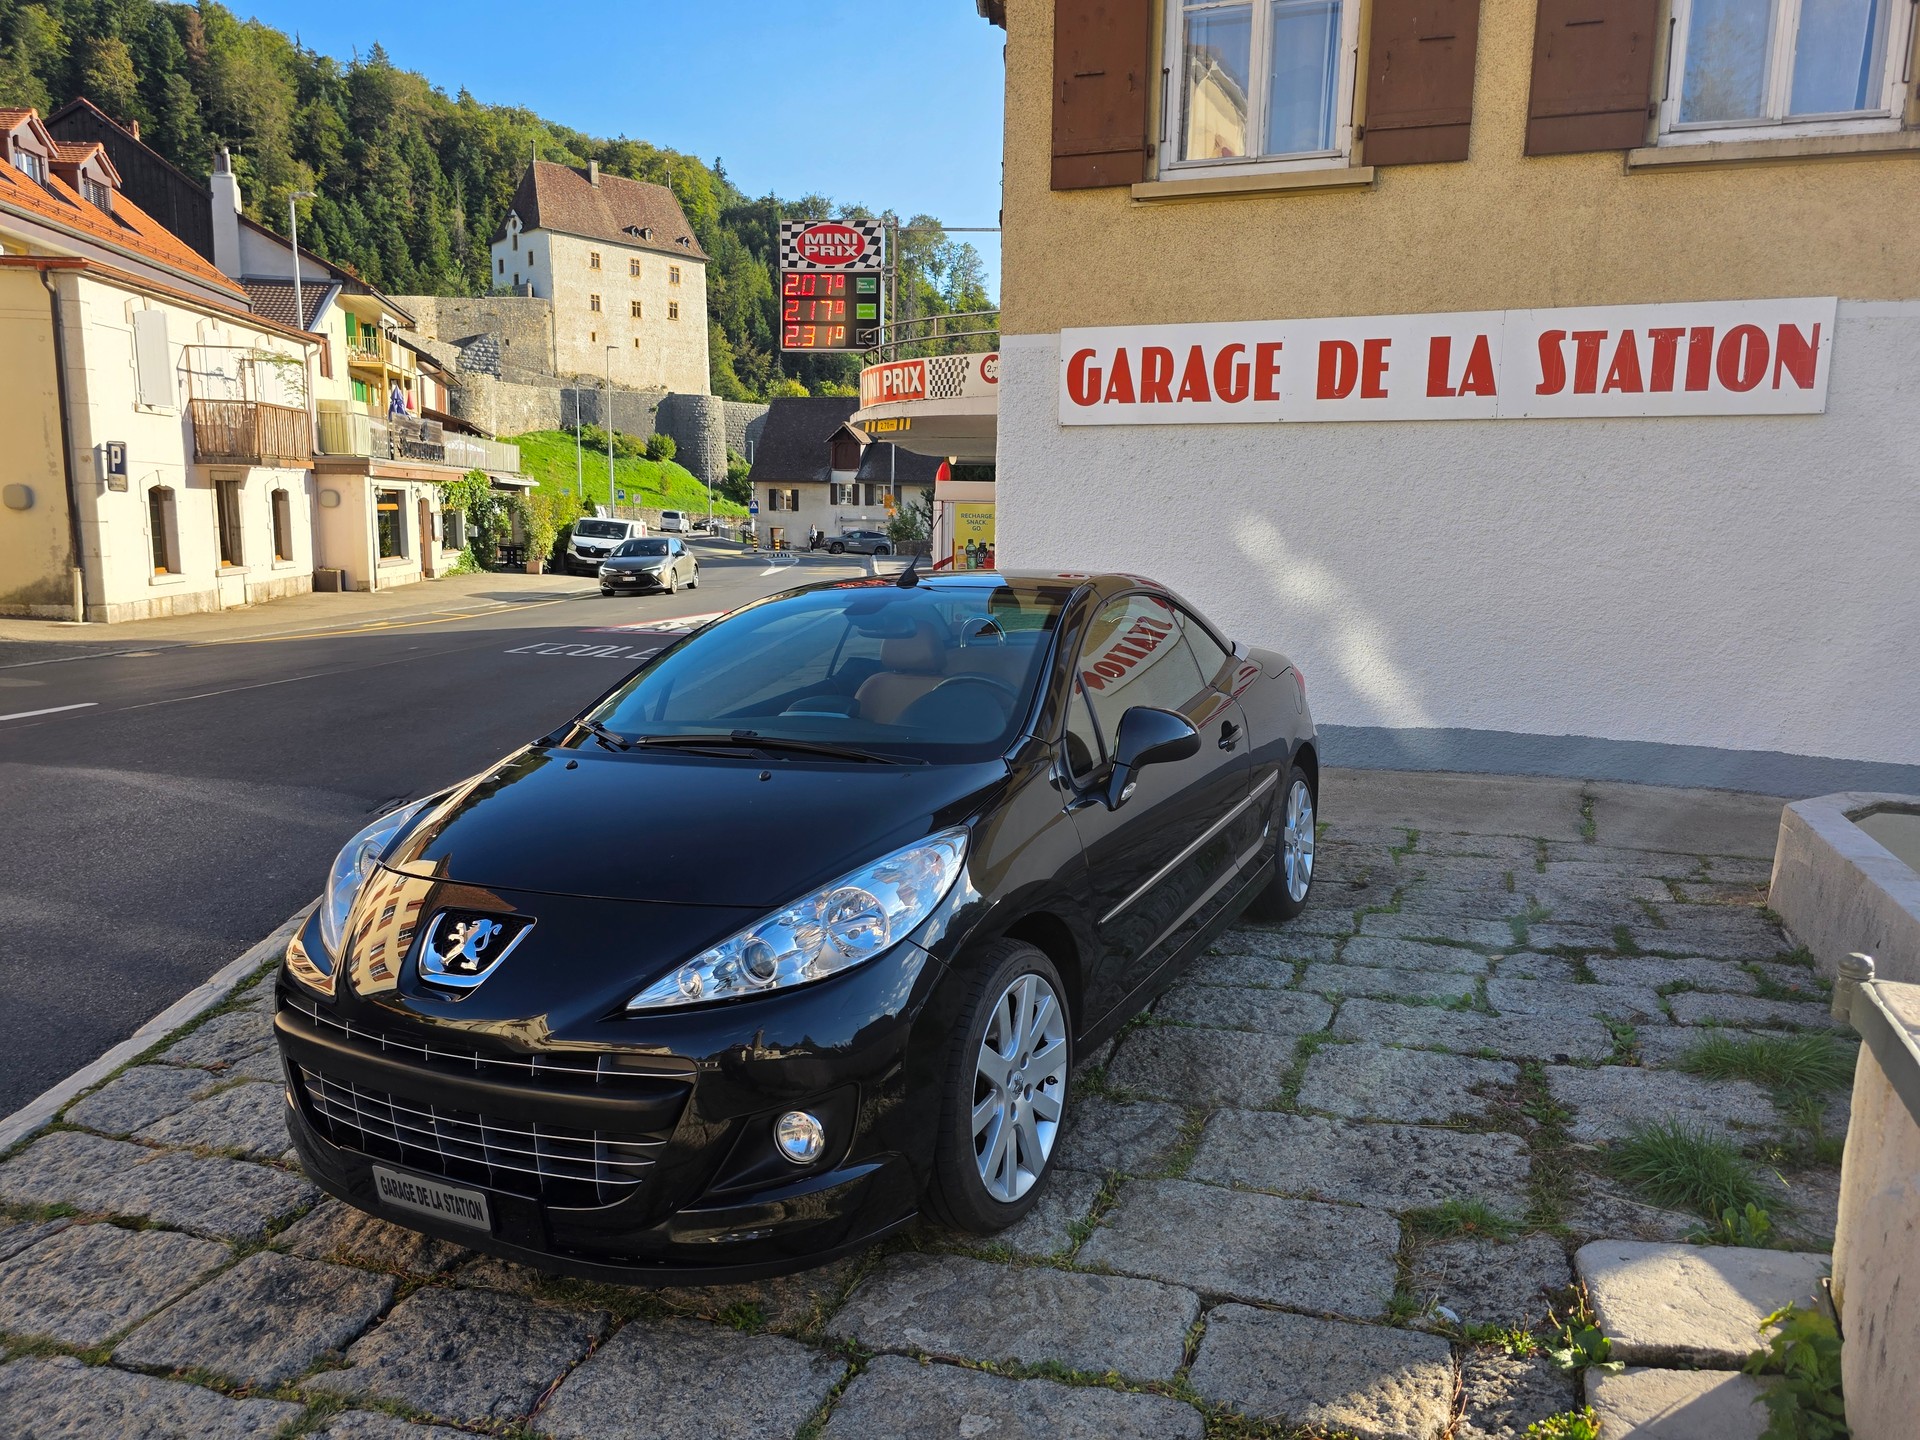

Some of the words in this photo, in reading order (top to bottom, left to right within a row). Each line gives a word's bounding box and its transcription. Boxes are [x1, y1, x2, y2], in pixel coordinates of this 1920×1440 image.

[804, 233, 858, 245] MINI
[804, 245, 859, 257] PRIX
[1066, 342, 1283, 407] GARAGE
[1316, 338, 1392, 400] DE
[1426, 334, 1498, 398] LA
[1535, 322, 1822, 395] STATION
[882, 365, 923, 397] PRIX
[111, 445, 122, 472] P
[380, 1175, 417, 1204] GARAGE
[416, 1185, 431, 1207] DE
[429, 1189, 444, 1211] LA
[443, 1193, 484, 1221] STATION
